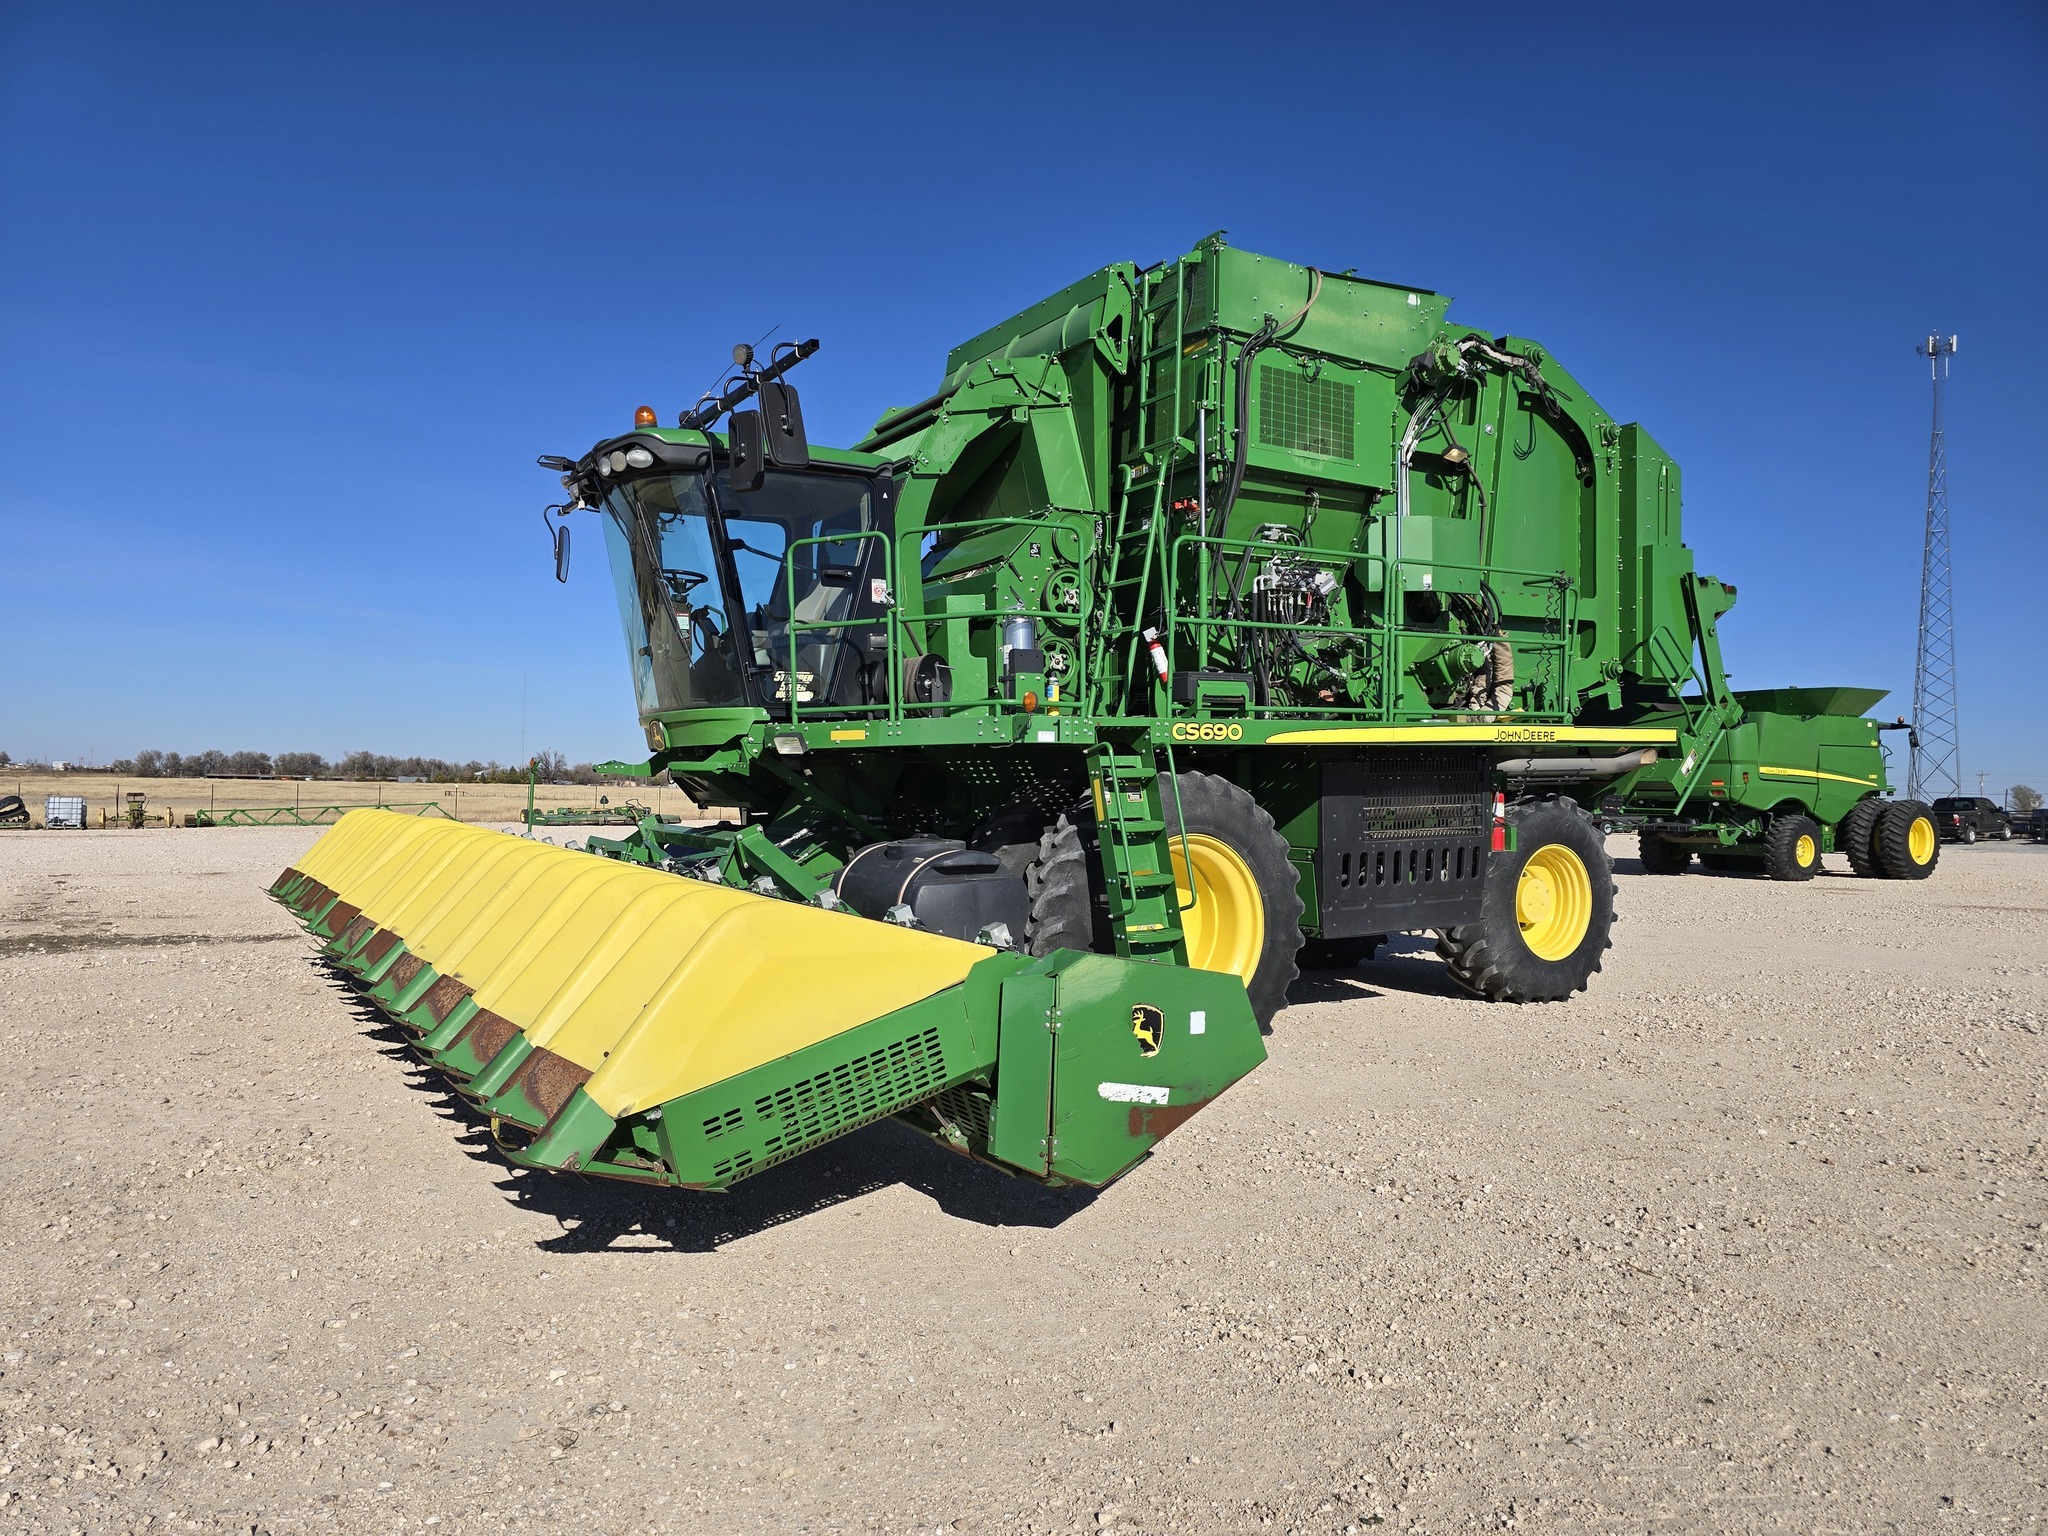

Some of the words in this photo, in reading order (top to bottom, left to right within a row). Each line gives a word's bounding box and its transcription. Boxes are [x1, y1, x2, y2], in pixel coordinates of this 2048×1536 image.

[1172, 722, 1243, 741] CS690
[1494, 728, 1521, 741] JOHN
[1523, 728, 1556, 741] DEERE
